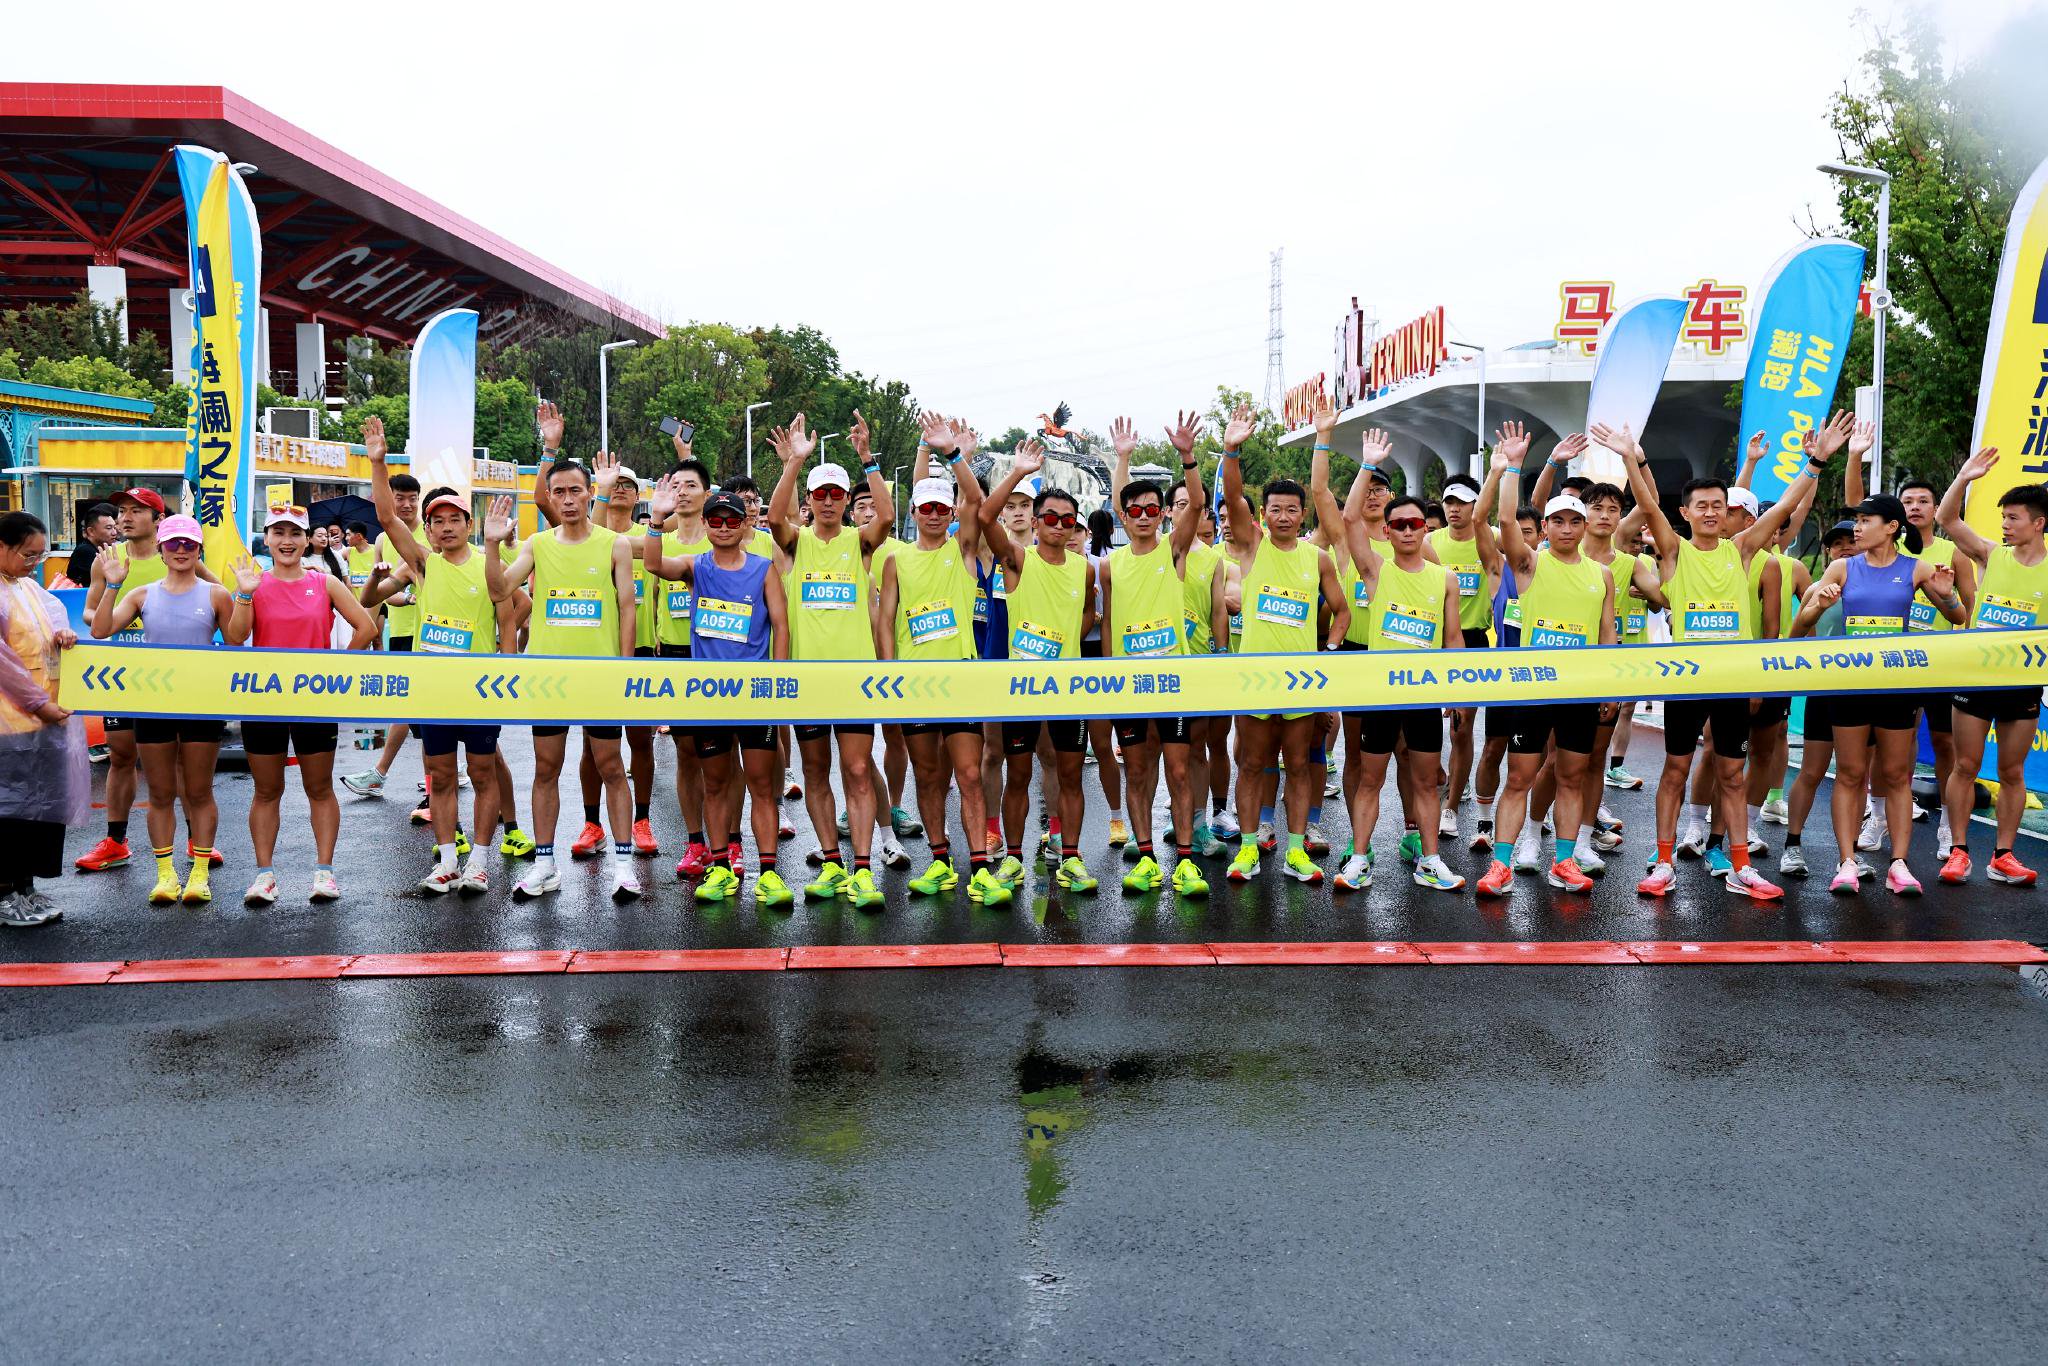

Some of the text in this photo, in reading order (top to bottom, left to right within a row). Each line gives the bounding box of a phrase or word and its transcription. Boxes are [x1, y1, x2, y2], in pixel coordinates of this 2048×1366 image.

[1371, 306, 1447, 391] TERMINAL
[1760, 328, 1802, 391] 澜跑
[1772, 335, 1834, 485] HLA POW
[671, 594, 692, 607] A05
[808, 586, 850, 599] A0576
[552, 603, 596, 616] A0569
[1262, 598, 1304, 617] A0593
[1982, 607, 2028, 627] A0602
[700, 613, 744, 631] A0574
[911, 613, 950, 635] A0578
[1389, 617, 1431, 637] A0603
[1691, 615, 1734, 628] A0598
[426, 628, 465, 646] A0619
[1018, 635, 1058, 657] A0575
[1130, 631, 1170, 650] A0577
[1536, 632, 1580, 647] A0570
[1761, 649, 1929, 671] HLA POW 澜跑
[230, 672, 410, 697] HLA POW 澜跑
[1009, 674, 1182, 695] HLA POW 澜跑
[1388, 665, 1558, 686] HLA POW 澜跑
[624, 677, 799, 699] HLA POW 澜跑
